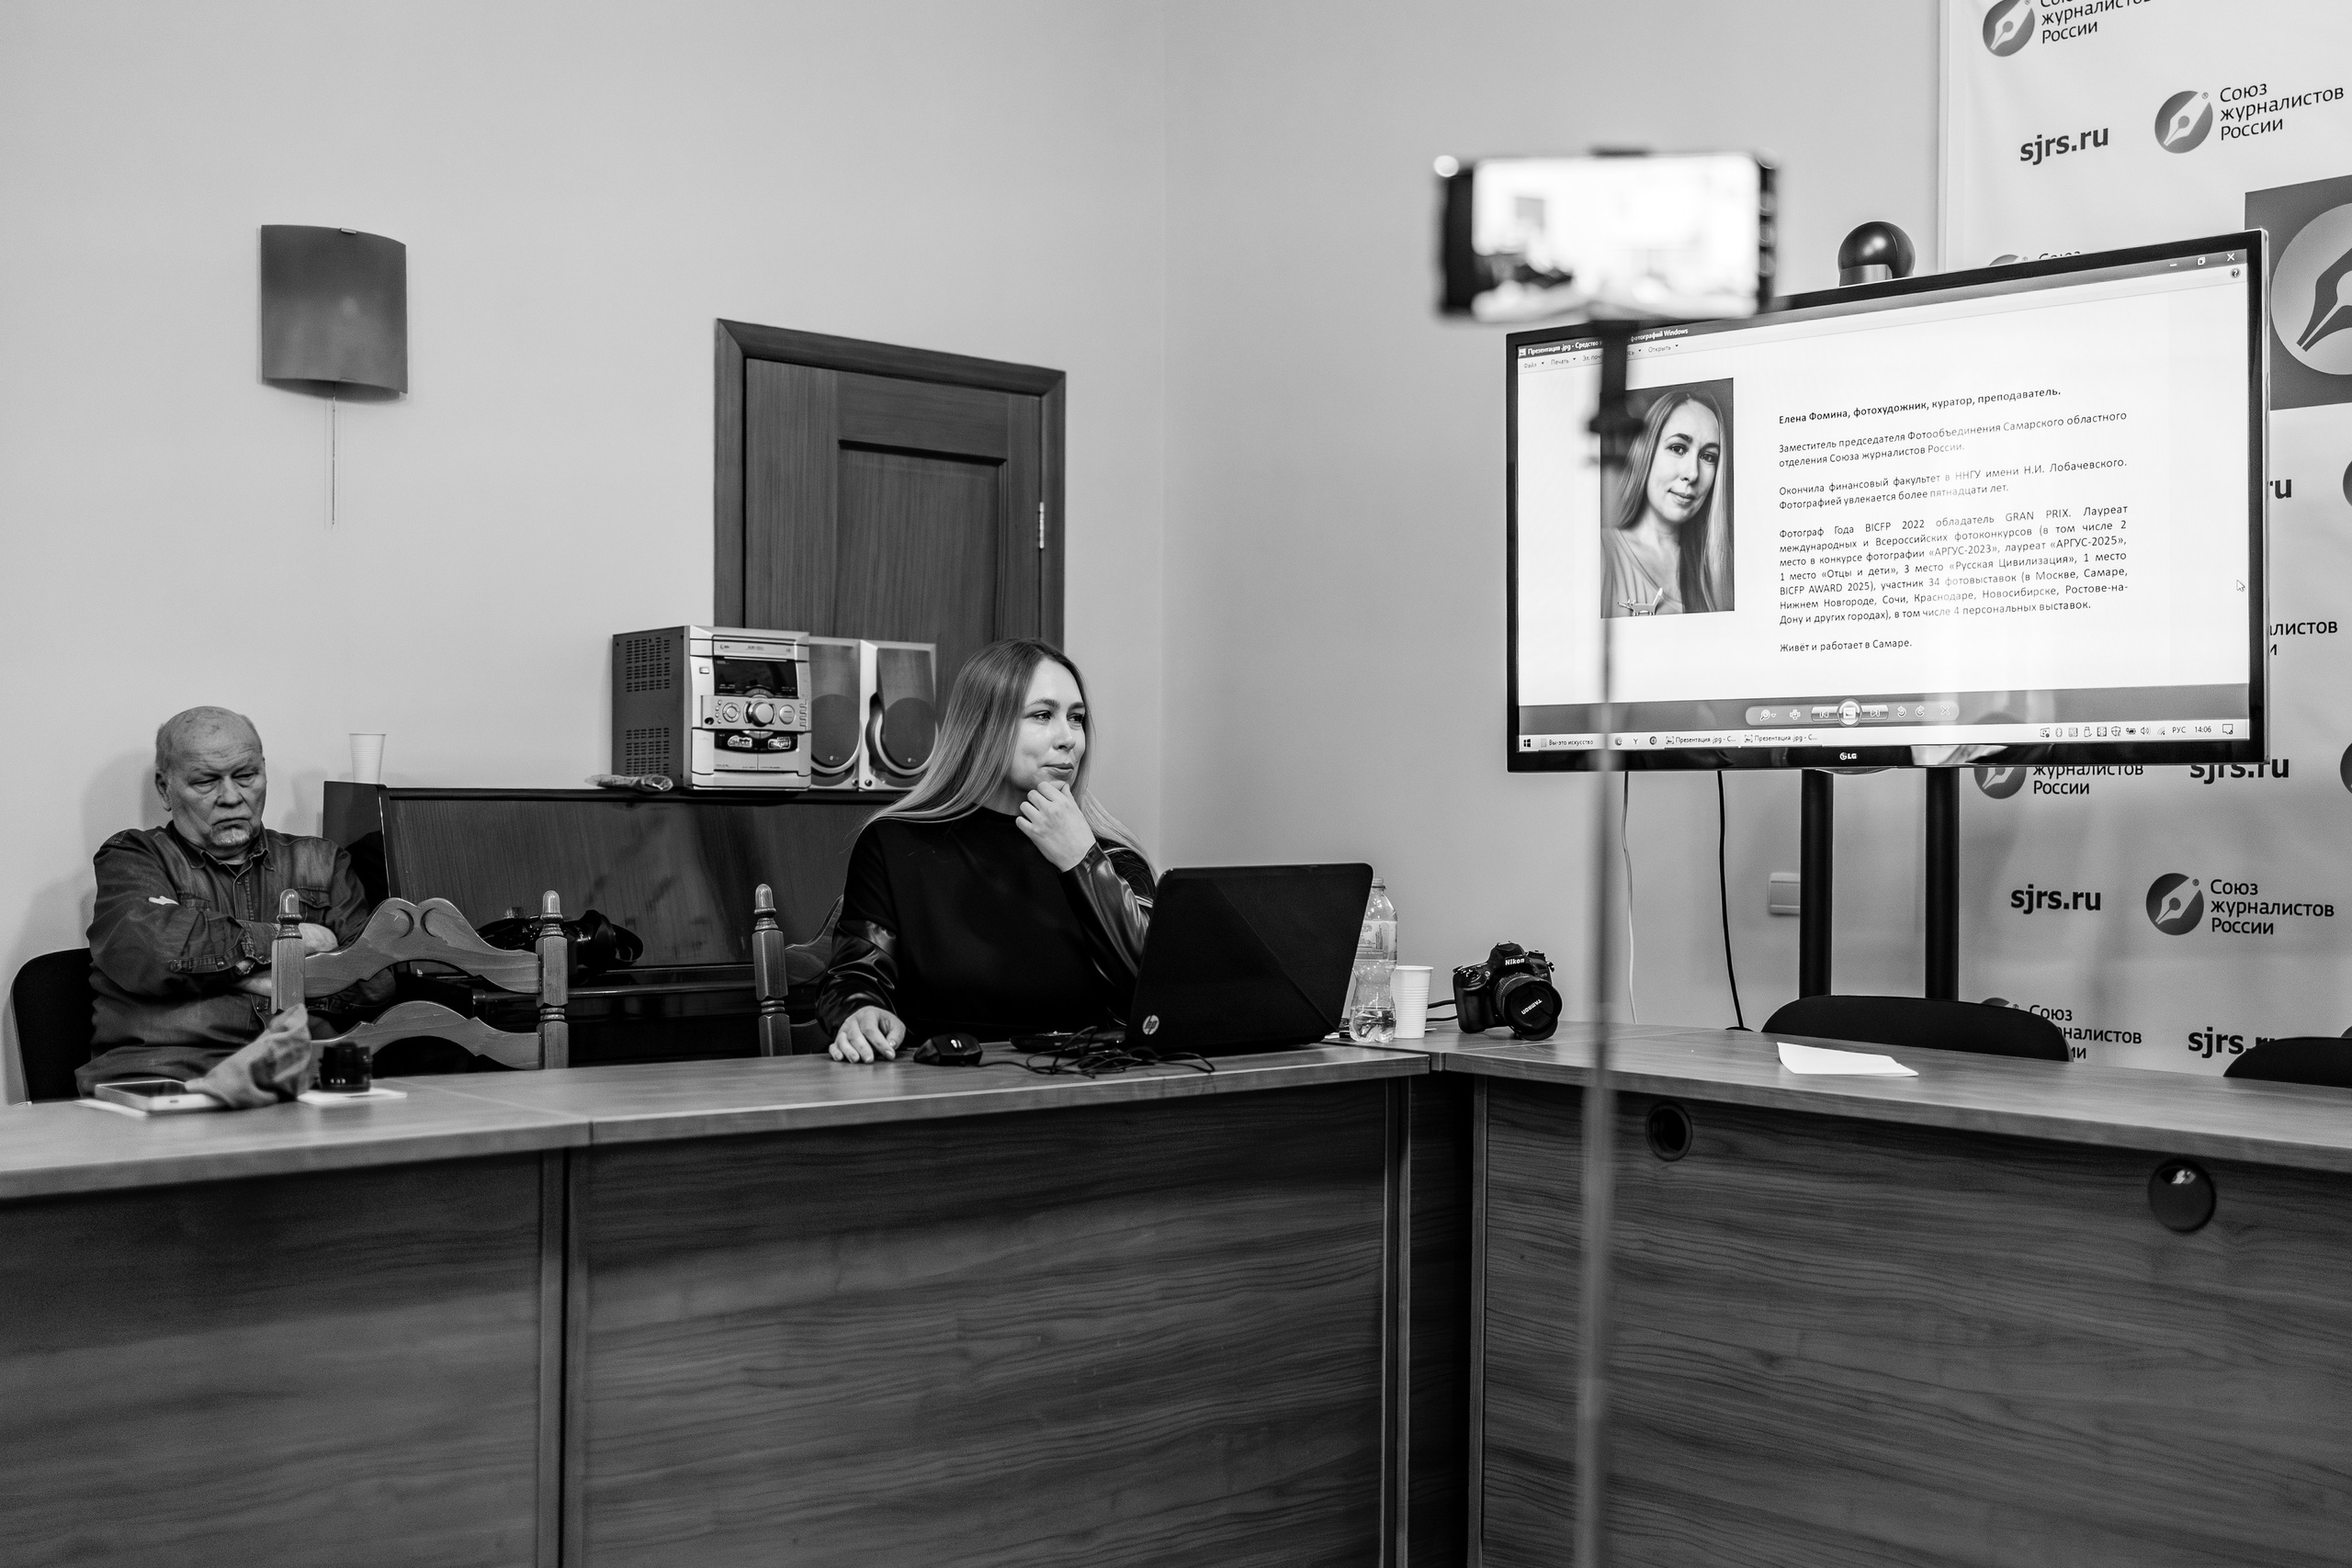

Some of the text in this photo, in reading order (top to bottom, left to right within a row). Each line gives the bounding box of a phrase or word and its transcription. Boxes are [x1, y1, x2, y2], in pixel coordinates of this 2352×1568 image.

[2041, 0, 2151, 26] журналист
[2041, 21, 2098, 44] России
[2220, 82, 2267, 103] Союз
[2220, 86, 2345, 122] журналистов
[2220, 118, 2284, 141] России
[2019, 128, 2109, 165] sjrs.ru
[1527, 344, 1561, 355] Презентация
[1664, 328, 1689, 337] Windows
[1550, 357, 1569, 367] Печать
[1647, 344, 1671, 355] Открыть
[1779, 389, 2061, 424] Елена Фомина, фотохудожник, куратор, преподаватель.
[1779, 412, 2128, 454] Заместитель председателя Фотообъединения Самарского областного
[1778, 444, 1965, 468] отделения Союза журналистов России.
[1779, 459, 2127, 496] Окончила финансовый факультет в ННГУ имени Н.И. Лобачевского.
[1779, 484, 2009, 510] Фотографией увлекается более пятнадцати лет.
[1779, 505, 2129, 538] Фотограф Года BICFP 2022 обладатель GRAN PRIX. Лауреат
[1779, 541, 1858, 553] международных
[1875, 534, 1948, 547] Всероссийских
[1953, 528, 2032, 541] фотоконкурсов
[2039, 525, 2049, 536] (в
[2054, 525, 2075, 534] том
[2082, 522, 2113, 532] числе
[2120, 519, 2127, 530] 2
[1779, 558, 1807, 567] место
[1818, 554, 1863, 564] конкурсе
[1865, 549, 1925, 562] фотографии
[2004, 542, 2046, 553] лауреат
[1780, 572, 1785, 581] 1
[1789, 571, 1817, 581] место
[1904, 563, 1910, 574] 3
[1914, 564, 1944, 573] место
[2084, 552, 2089, 562] 1
[2095, 552, 2127, 561] место
[1780, 568, 2128, 596] BICFP AWARD 2025), участник 34 фотовыставок (в Москве, Самаре,
[1780, 583, 2128, 610] Нижнем Новгороде, Сочи, Краснодаре, Новосибирске, Ростове-на-
[1779, 615, 1804, 626] Дону
[1813, 614, 1846, 624] других
[1847, 609, 1892, 622] городах),
[1894, 611, 1900, 619] в
[1901, 610, 1921, 618] том
[1922, 608, 1951, 616] числе
[1962, 604, 2037, 615] персональных
[2039, 601, 2091, 611] выставок.
[2269, 621, 2338, 637] листов
[1780, 641, 1810, 652] Живёт
[1820, 640, 1863, 652] работает
[1864, 641, 1871, 649] в
[1871, 638, 1912, 649] Самаре.
[1675, 736, 1710, 744] Презентация
[1754, 735, 1791, 743] Презентация
[2171, 725, 2187, 735] РУС
[2194, 725, 2212, 735] 14:06
[2032, 765, 2144, 780] журналистов
[2189, 758, 2290, 784] sjrs.ru
[2033, 780, 2090, 795] России
[2210, 878, 2259, 896] Союз
[2010, 884, 2102, 915] sjrs.ru
[2210, 899, 2335, 918] журналистов
[2211, 918, 2275, 935] России
[1504, 957, 1525, 966] Nikon
[1521, 998, 1543, 1015] TAMRON
[1144, 1014, 1159, 1035] hp
[2058, 1026, 2143, 1044] налистов
[2188, 1026, 2276, 1059] sjrs
